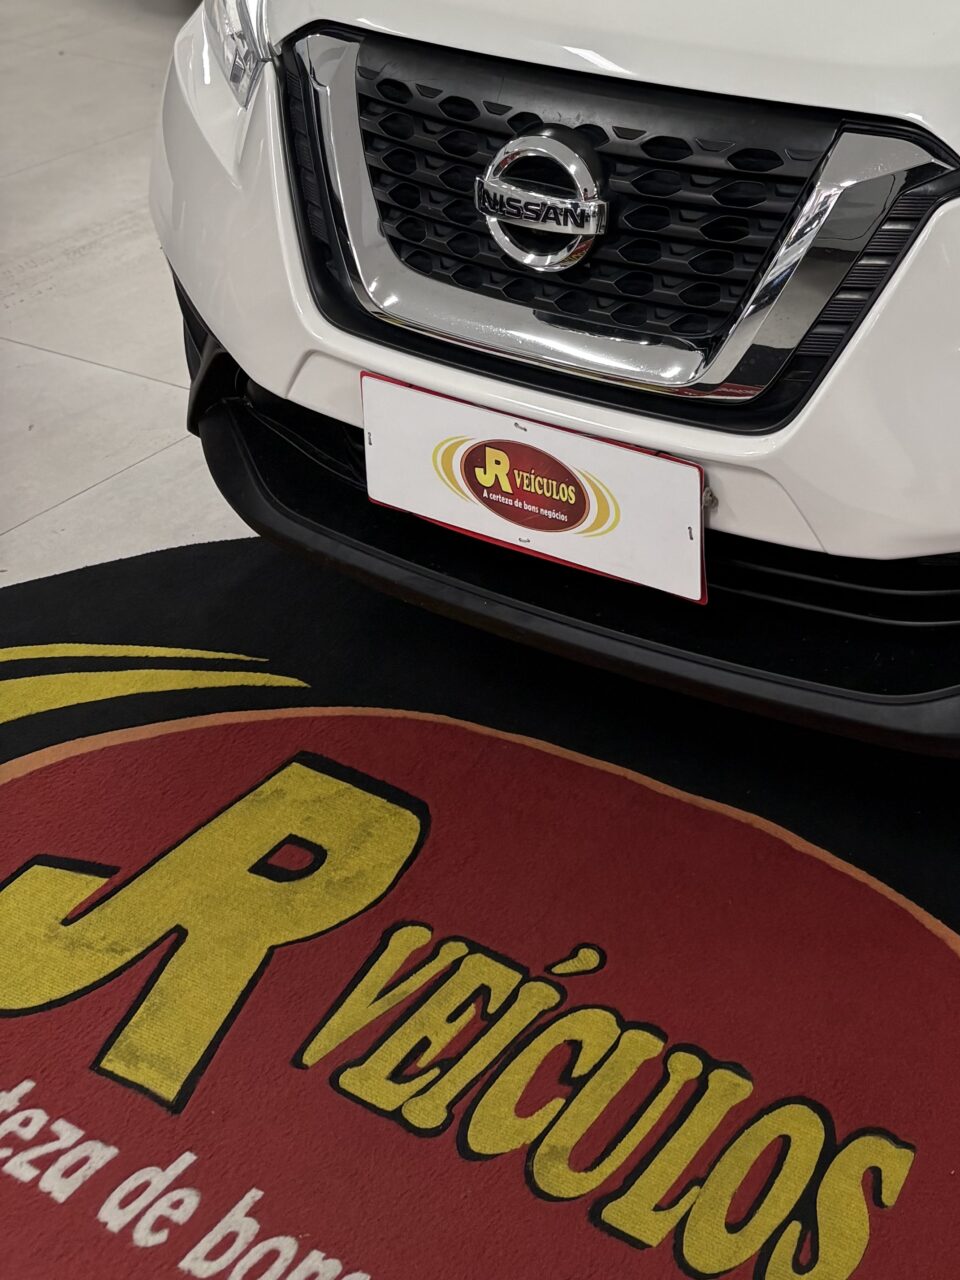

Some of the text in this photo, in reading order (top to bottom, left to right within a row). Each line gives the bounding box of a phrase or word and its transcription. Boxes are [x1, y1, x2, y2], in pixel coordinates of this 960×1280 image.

[480, 187, 586, 229] NISSAN
[474, 445, 577, 505] JR VEÍCULOS
[482, 488, 568, 522] A certeza de bons negócios
[0, 752, 916, 1280] JR VEÍCULOS
[96, 1150, 201, 1248] de
[177, 1186, 371, 1280] bon
